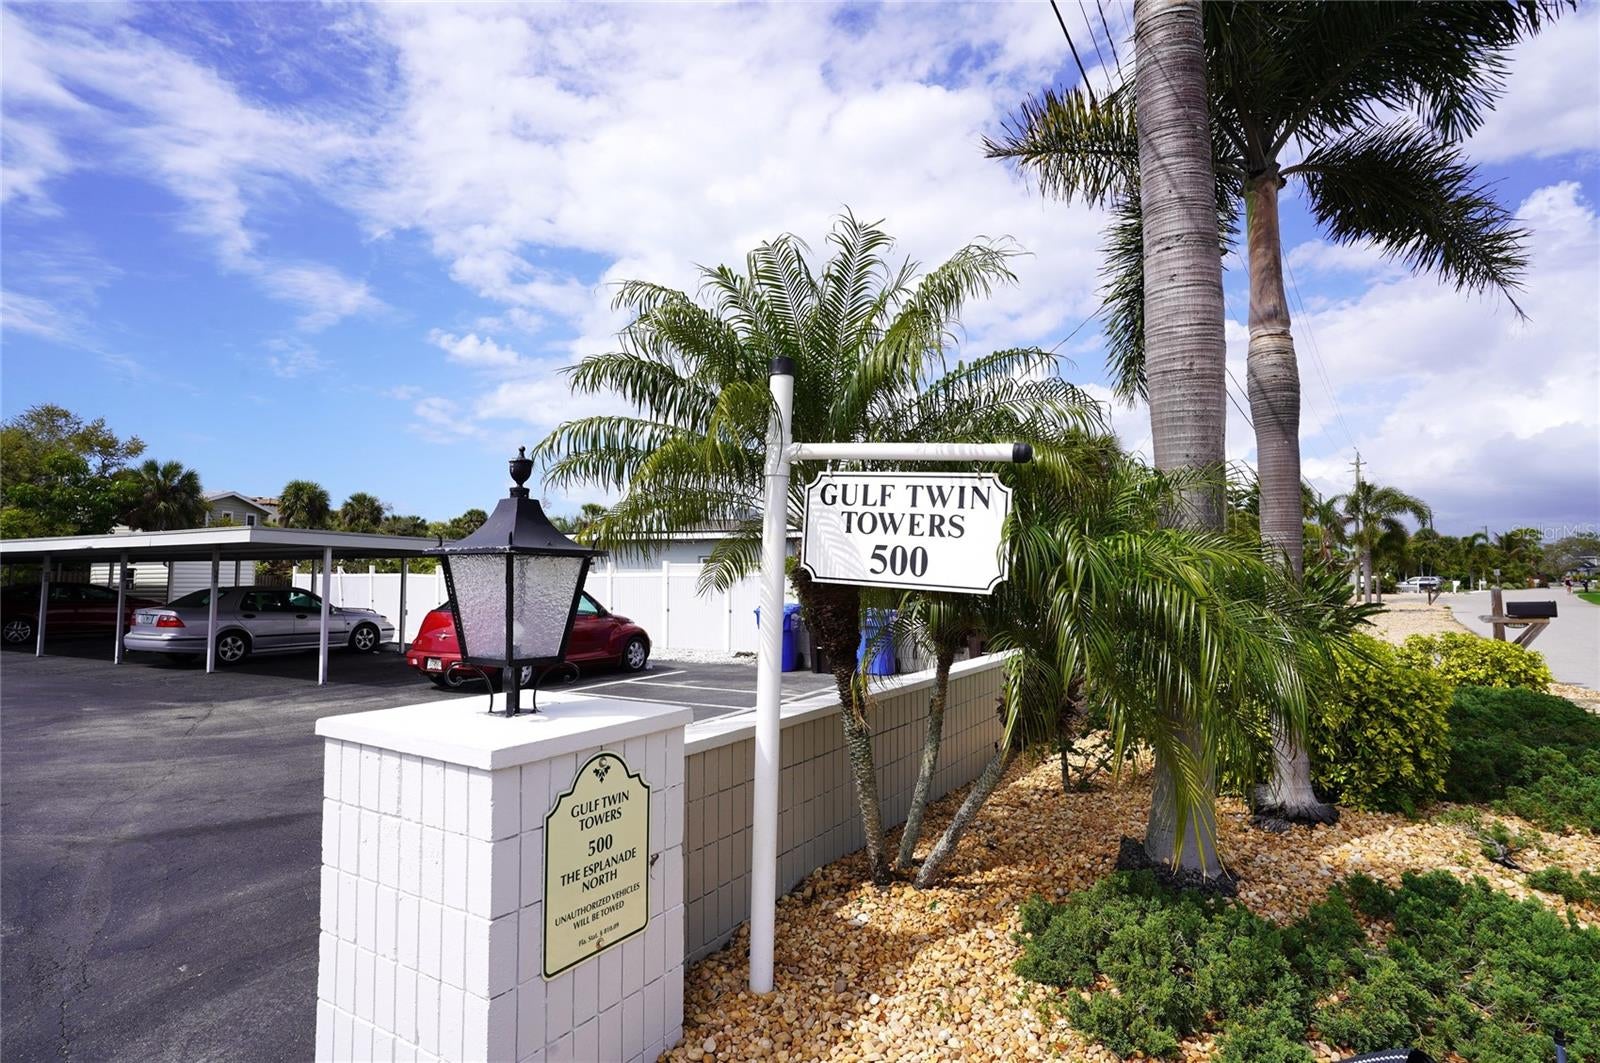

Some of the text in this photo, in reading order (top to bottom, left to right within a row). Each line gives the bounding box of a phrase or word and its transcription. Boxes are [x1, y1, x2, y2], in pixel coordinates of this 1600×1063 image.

[820, 483, 991, 510] GULF TWIN
[841, 511, 965, 539] TOWERS
[869, 544, 929, 577] 500
[570, 790, 630, 818] GULF TWIN
[578, 806, 622, 832] TOWERS
[587, 833, 613, 857] 500
[560, 847, 637, 887] THE ESPLANADE
[581, 868, 618, 893] NORTH
[554, 881, 641, 927] UNAUTHORIZED VEHICLES
[573, 900, 625, 930] WILL BE TOWED
